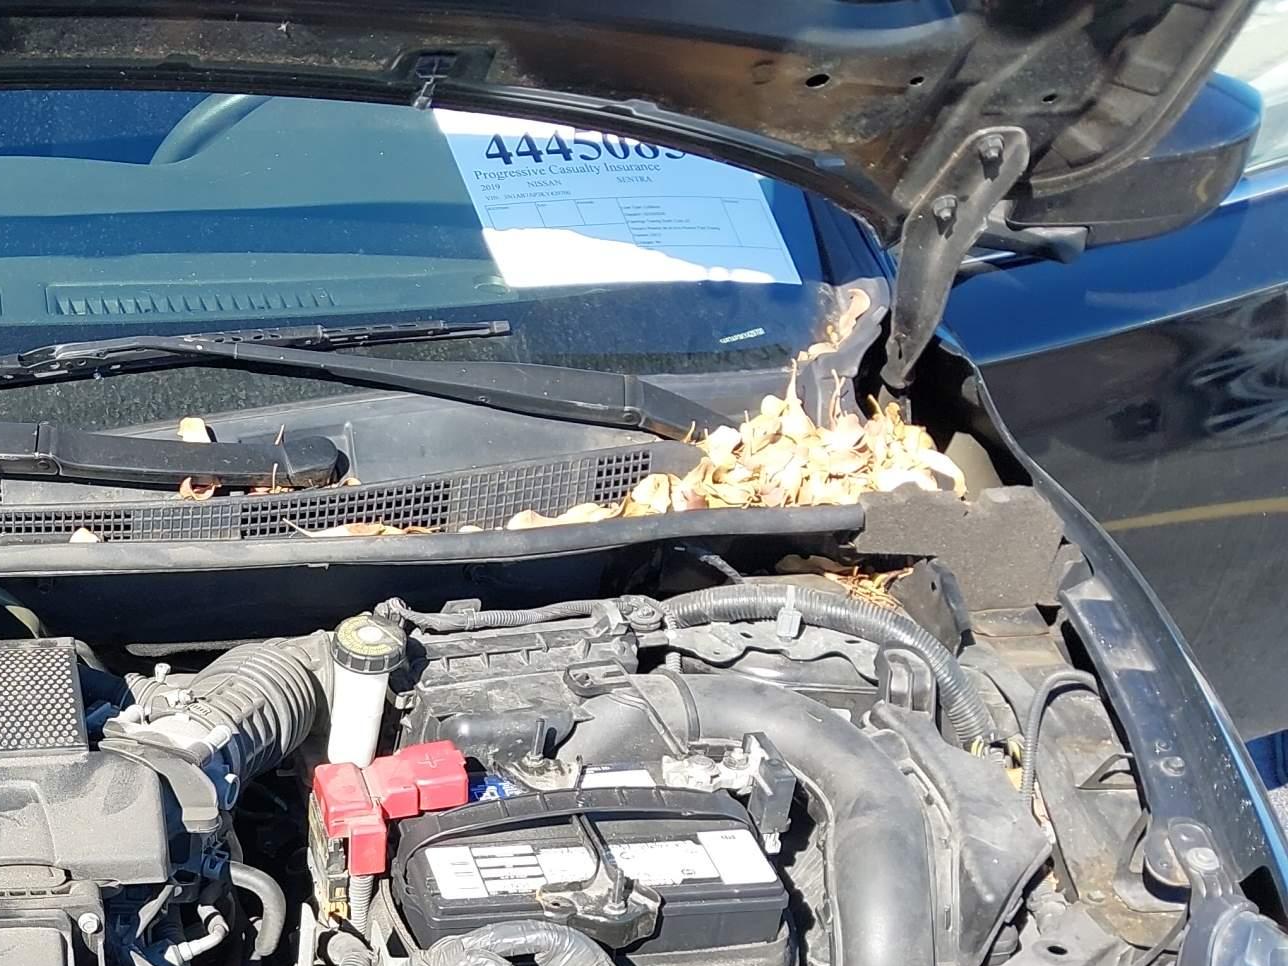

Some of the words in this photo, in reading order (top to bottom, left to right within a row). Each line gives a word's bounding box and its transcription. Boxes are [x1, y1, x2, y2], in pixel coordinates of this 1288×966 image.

[474, 166, 546, 182] Progressive
[549, 162, 601, 176] Casualty
[604, 162, 662, 173] Insurance
[480, 183, 501, 192] 2019
[527, 179, 562, 188] NISSAN
[616, 175, 653, 183] SENTRA
